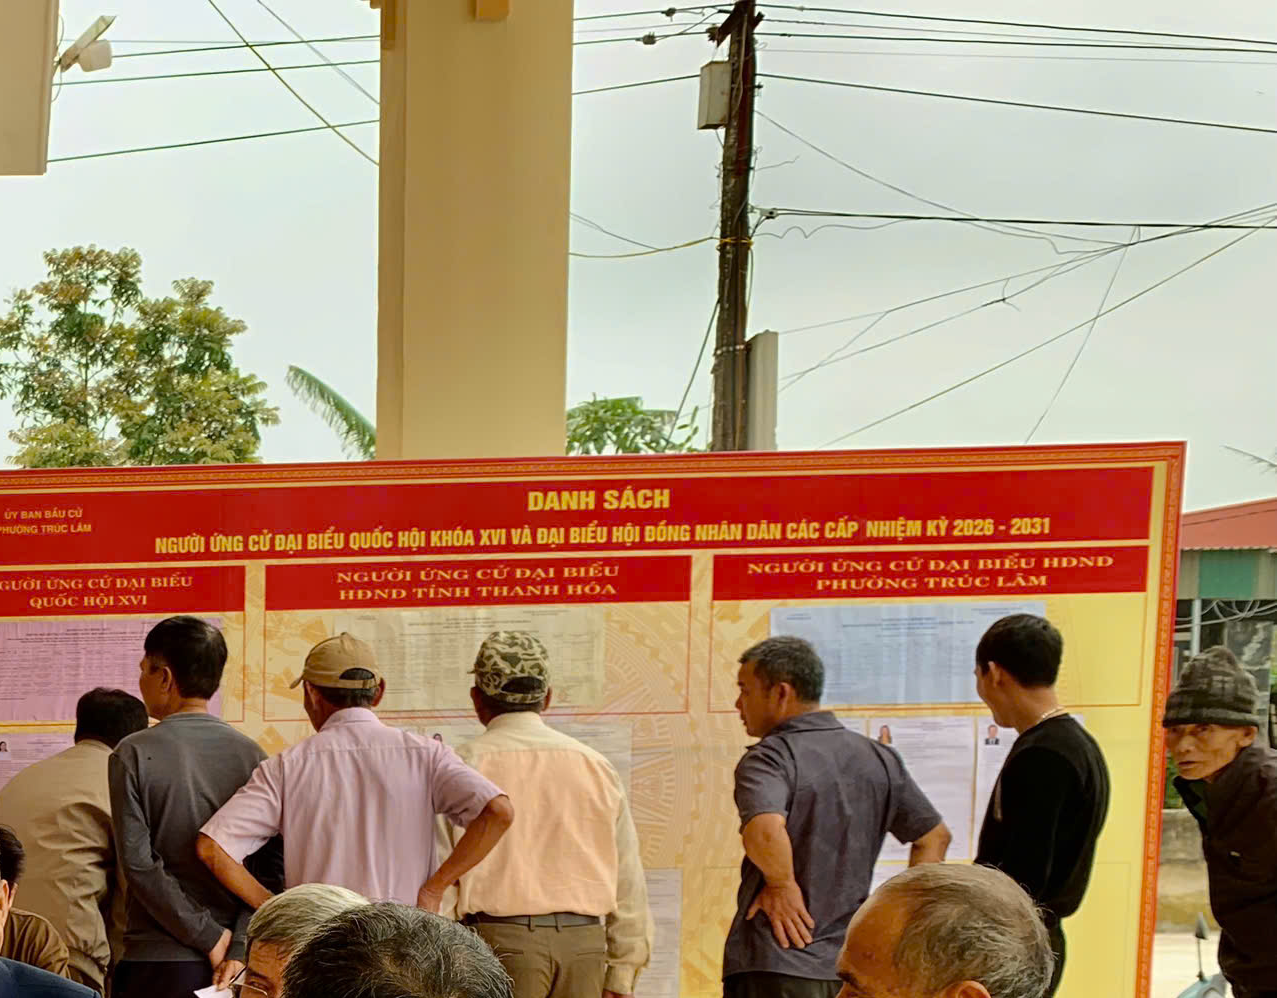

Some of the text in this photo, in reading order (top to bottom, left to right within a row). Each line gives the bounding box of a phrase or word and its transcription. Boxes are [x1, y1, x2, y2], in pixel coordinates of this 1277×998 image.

[528, 486, 671, 511] DANH SÁCH
[20, 510, 42, 519] BAN
[41, 522, 68, 533] TRÚC
[70, 522, 92, 533] LÂM
[155, 534, 205, 554] NGƯỜI
[210, 530, 244, 552] ỨNG
[248, 530, 272, 551] CỬ
[275, 534, 303, 555] ĐẠI
[307, 527, 345, 550] BIỂU
[350, 526, 393, 550] QUỐC
[398, 528, 425, 552] HỘI
[431, 526, 474, 548] KHÓA
[479, 529, 507, 546] XVI
[511, 525, 532, 545] VÀ
[536, 527, 565, 548] ĐẠI
[570, 520, 608, 544] BIỂU
[612, 522, 640, 546] HỘI
[644, 520, 691, 543] ĐỒNG
[695, 521, 742, 541] NHÂN
[746, 519, 783, 541] DÂN
[786, 518, 821, 539] CÁC
[824, 515, 859, 539] CẤP
[866, 517, 923, 541] NHIỆM
[926, 516, 949, 537] KỲ
[952, 518, 995, 536] 2026
[1010, 516, 1051, 535] 2031
[336, 568, 412, 584] NGƯỜI
[419, 567, 470, 582] ỨNG
[515, 567, 556, 582] ĐẠI
[562, 561, 620, 579] BIỂU
[747, 558, 824, 575] NGƯỜI
[832, 557, 883, 573] ỨNG
[888, 556, 925, 572] CỬ
[978, 552, 1037, 570] BIỂU
[46, 575, 84, 590] ỨNG
[87, 574, 113, 589] CỬ
[151, 571, 193, 588] BIỂU
[339, 580, 617, 601] HĐND TỈNH THANH HÓA
[816, 573, 1048, 591] PHƯỜNG TRÚC LÂM
[29, 593, 148, 609] QUỐC HỘI XVI
